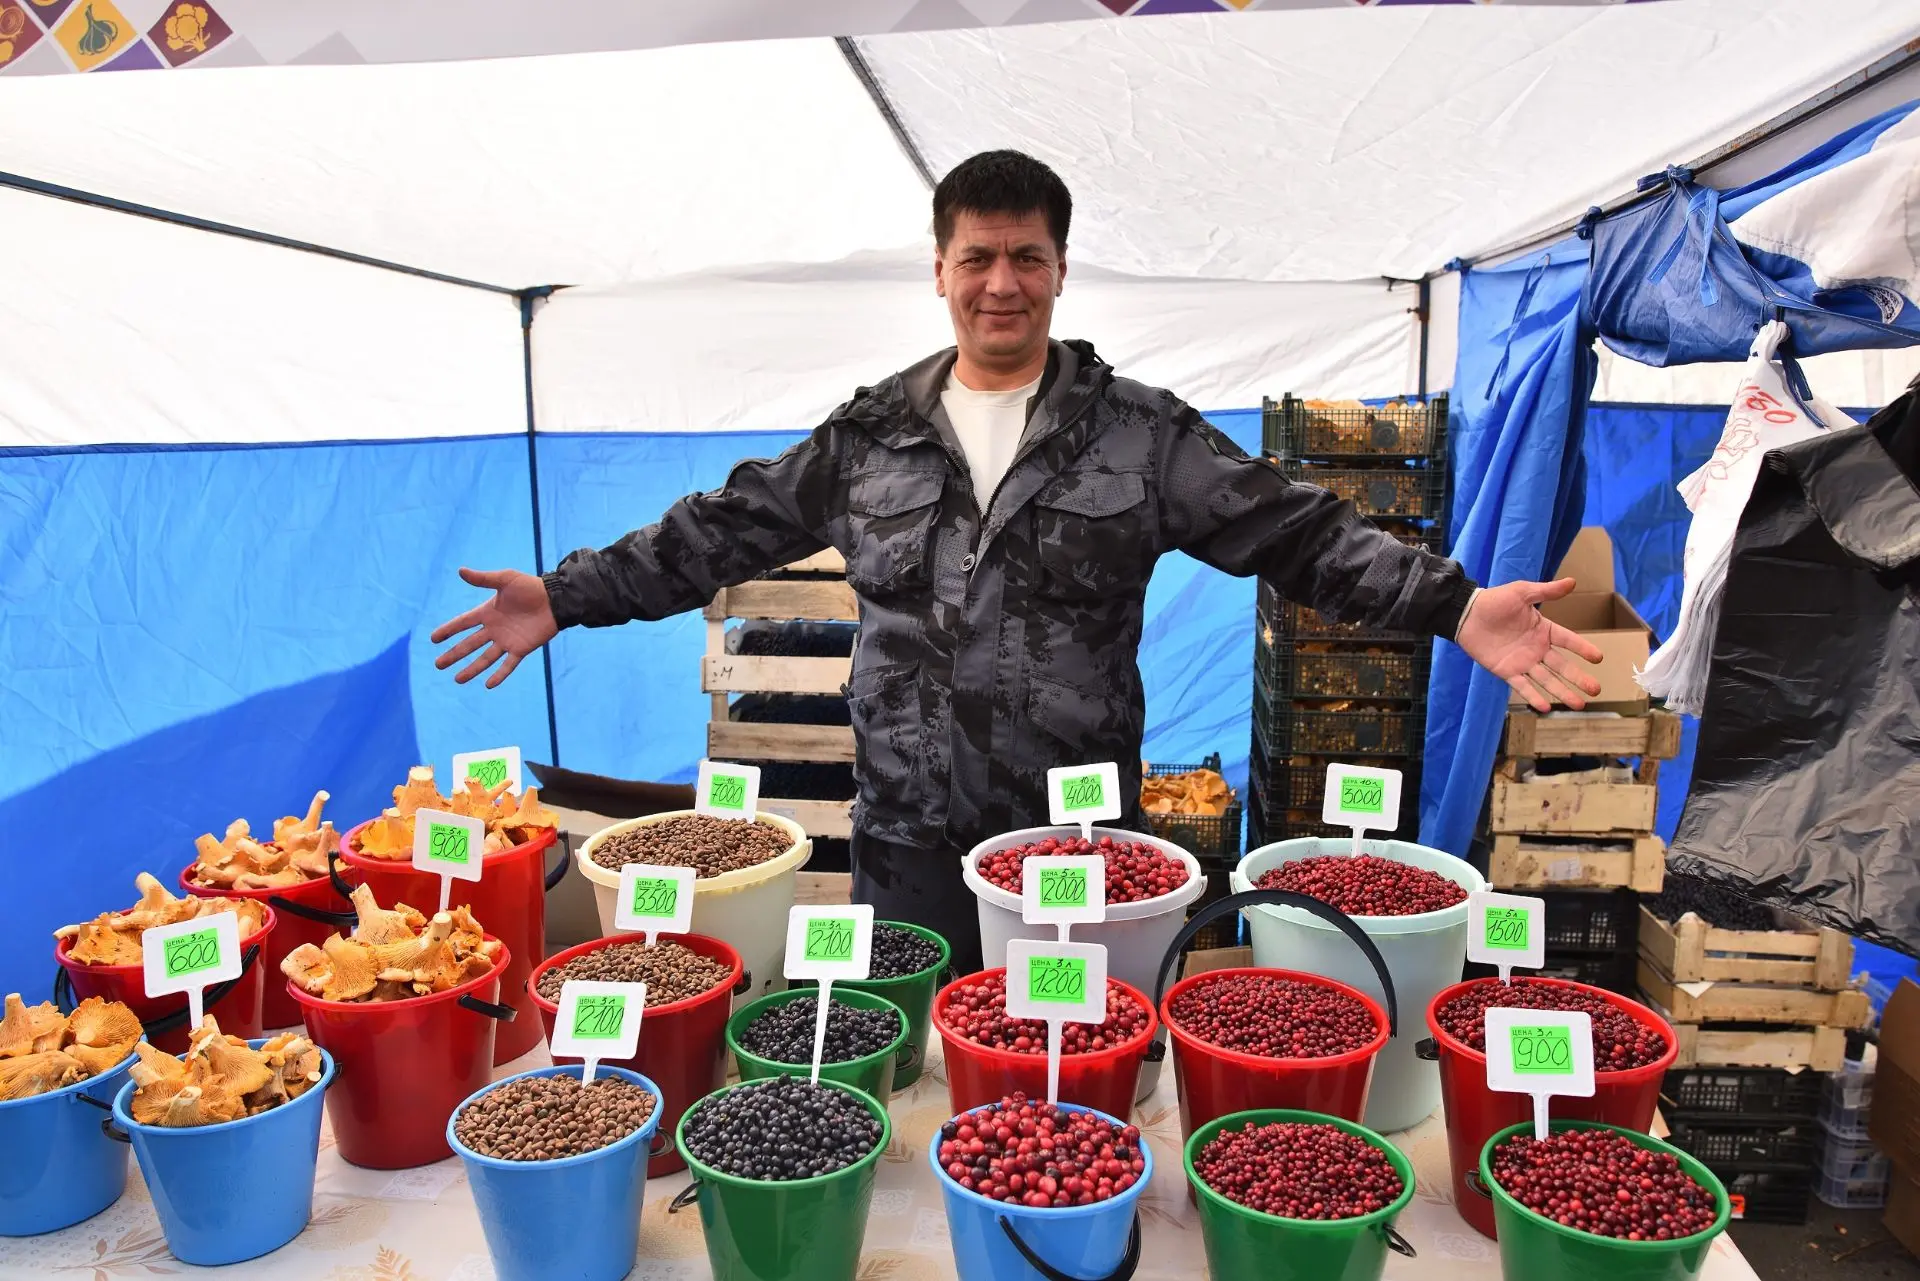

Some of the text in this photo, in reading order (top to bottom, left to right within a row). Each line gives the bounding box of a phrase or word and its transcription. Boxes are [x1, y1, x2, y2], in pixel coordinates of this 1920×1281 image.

[712, 783, 743, 803] 7000
[1066, 784, 1101, 805] 4000
[1343, 788, 1382, 805] 3000
[432, 832, 466, 857] 900
[634, 888, 677, 912] 3500
[1043, 877, 1085, 901] 2000
[807, 929, 851, 956] 2100
[1487, 919, 1523, 942] 1500
[166, 939, 185, 948] ЦЕНА
[170, 939, 216, 972] 600
[1033, 968, 1081, 995] 1200
[575, 1004, 624, 1035] 2100
[1517, 1037, 1568, 1066] 900
